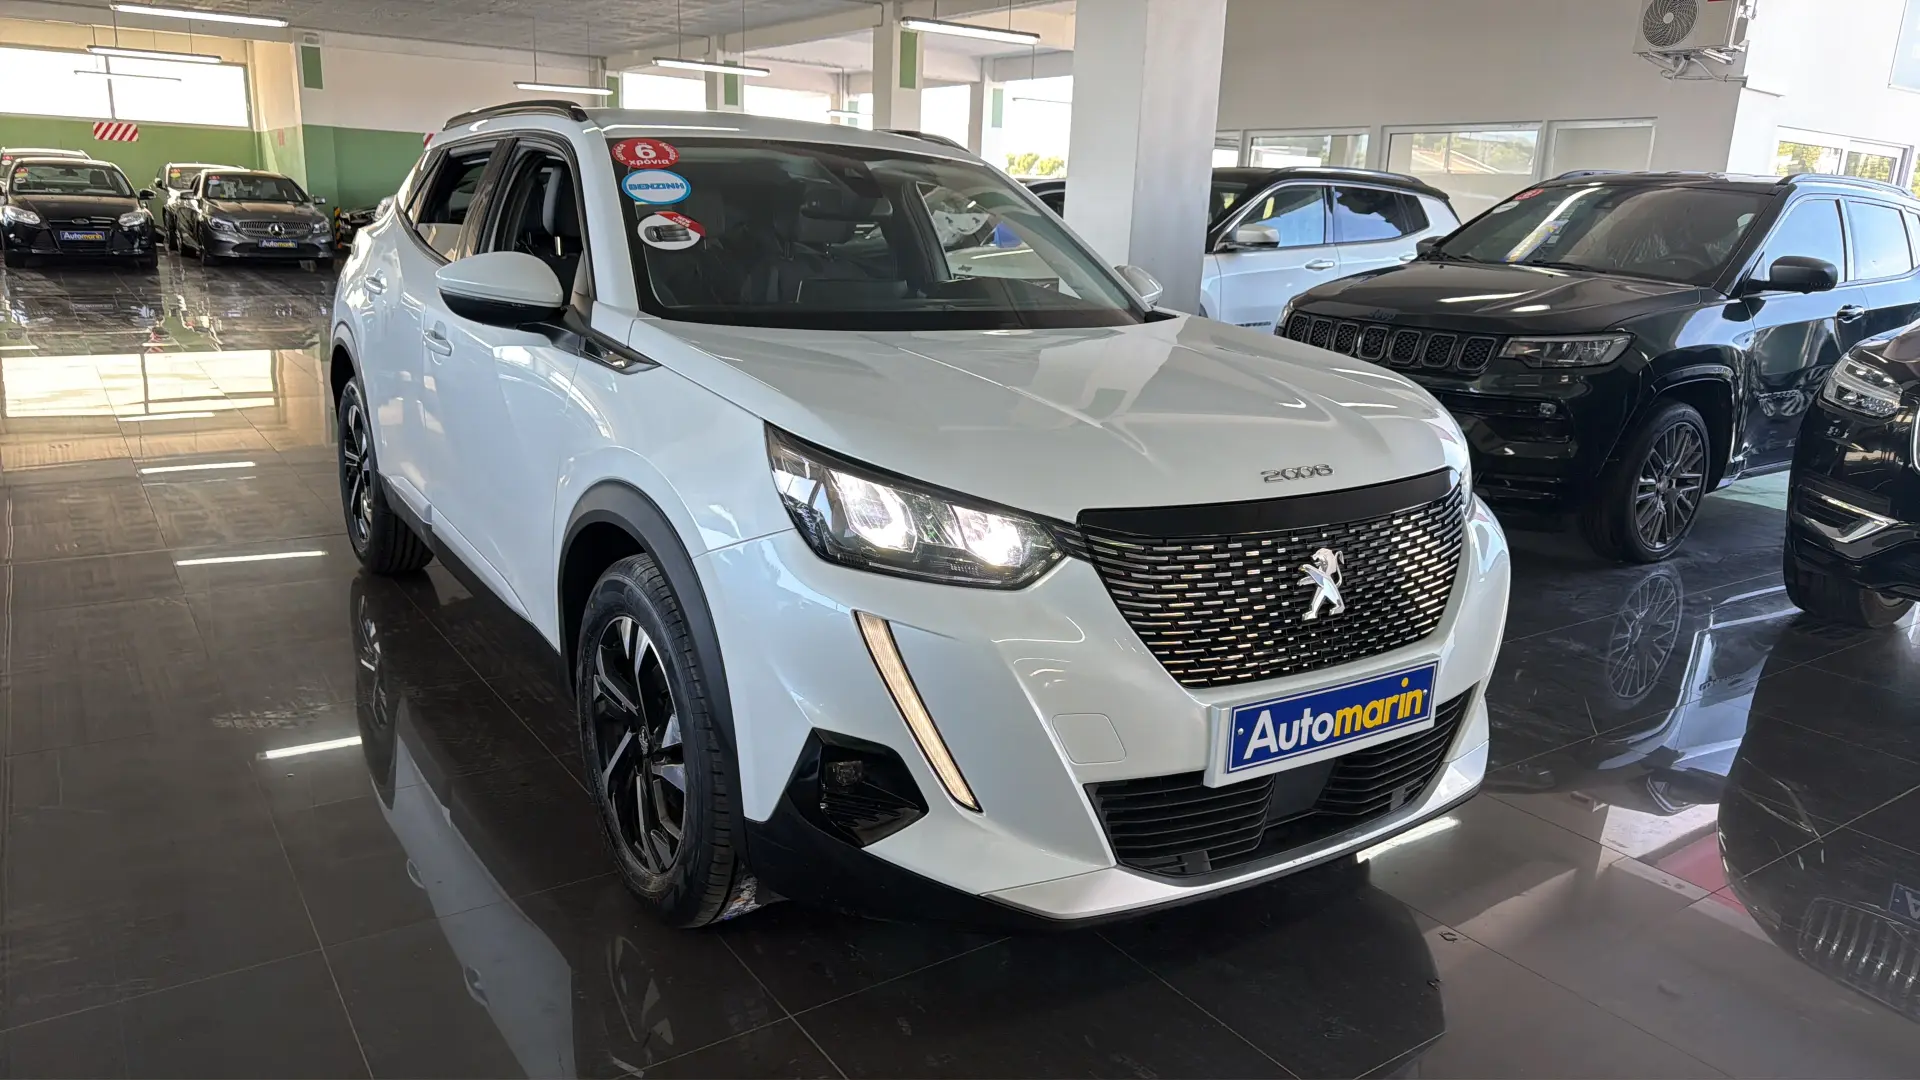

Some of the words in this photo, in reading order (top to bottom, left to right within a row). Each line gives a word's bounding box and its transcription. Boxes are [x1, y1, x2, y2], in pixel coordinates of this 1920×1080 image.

[635, 144, 657, 159] 6
[629, 157, 670, 166] χρόνια
[63, 232, 103, 240] Automarin
[1260, 463, 1334, 483] 2008
[1242, 677, 1423, 760] Automarin
